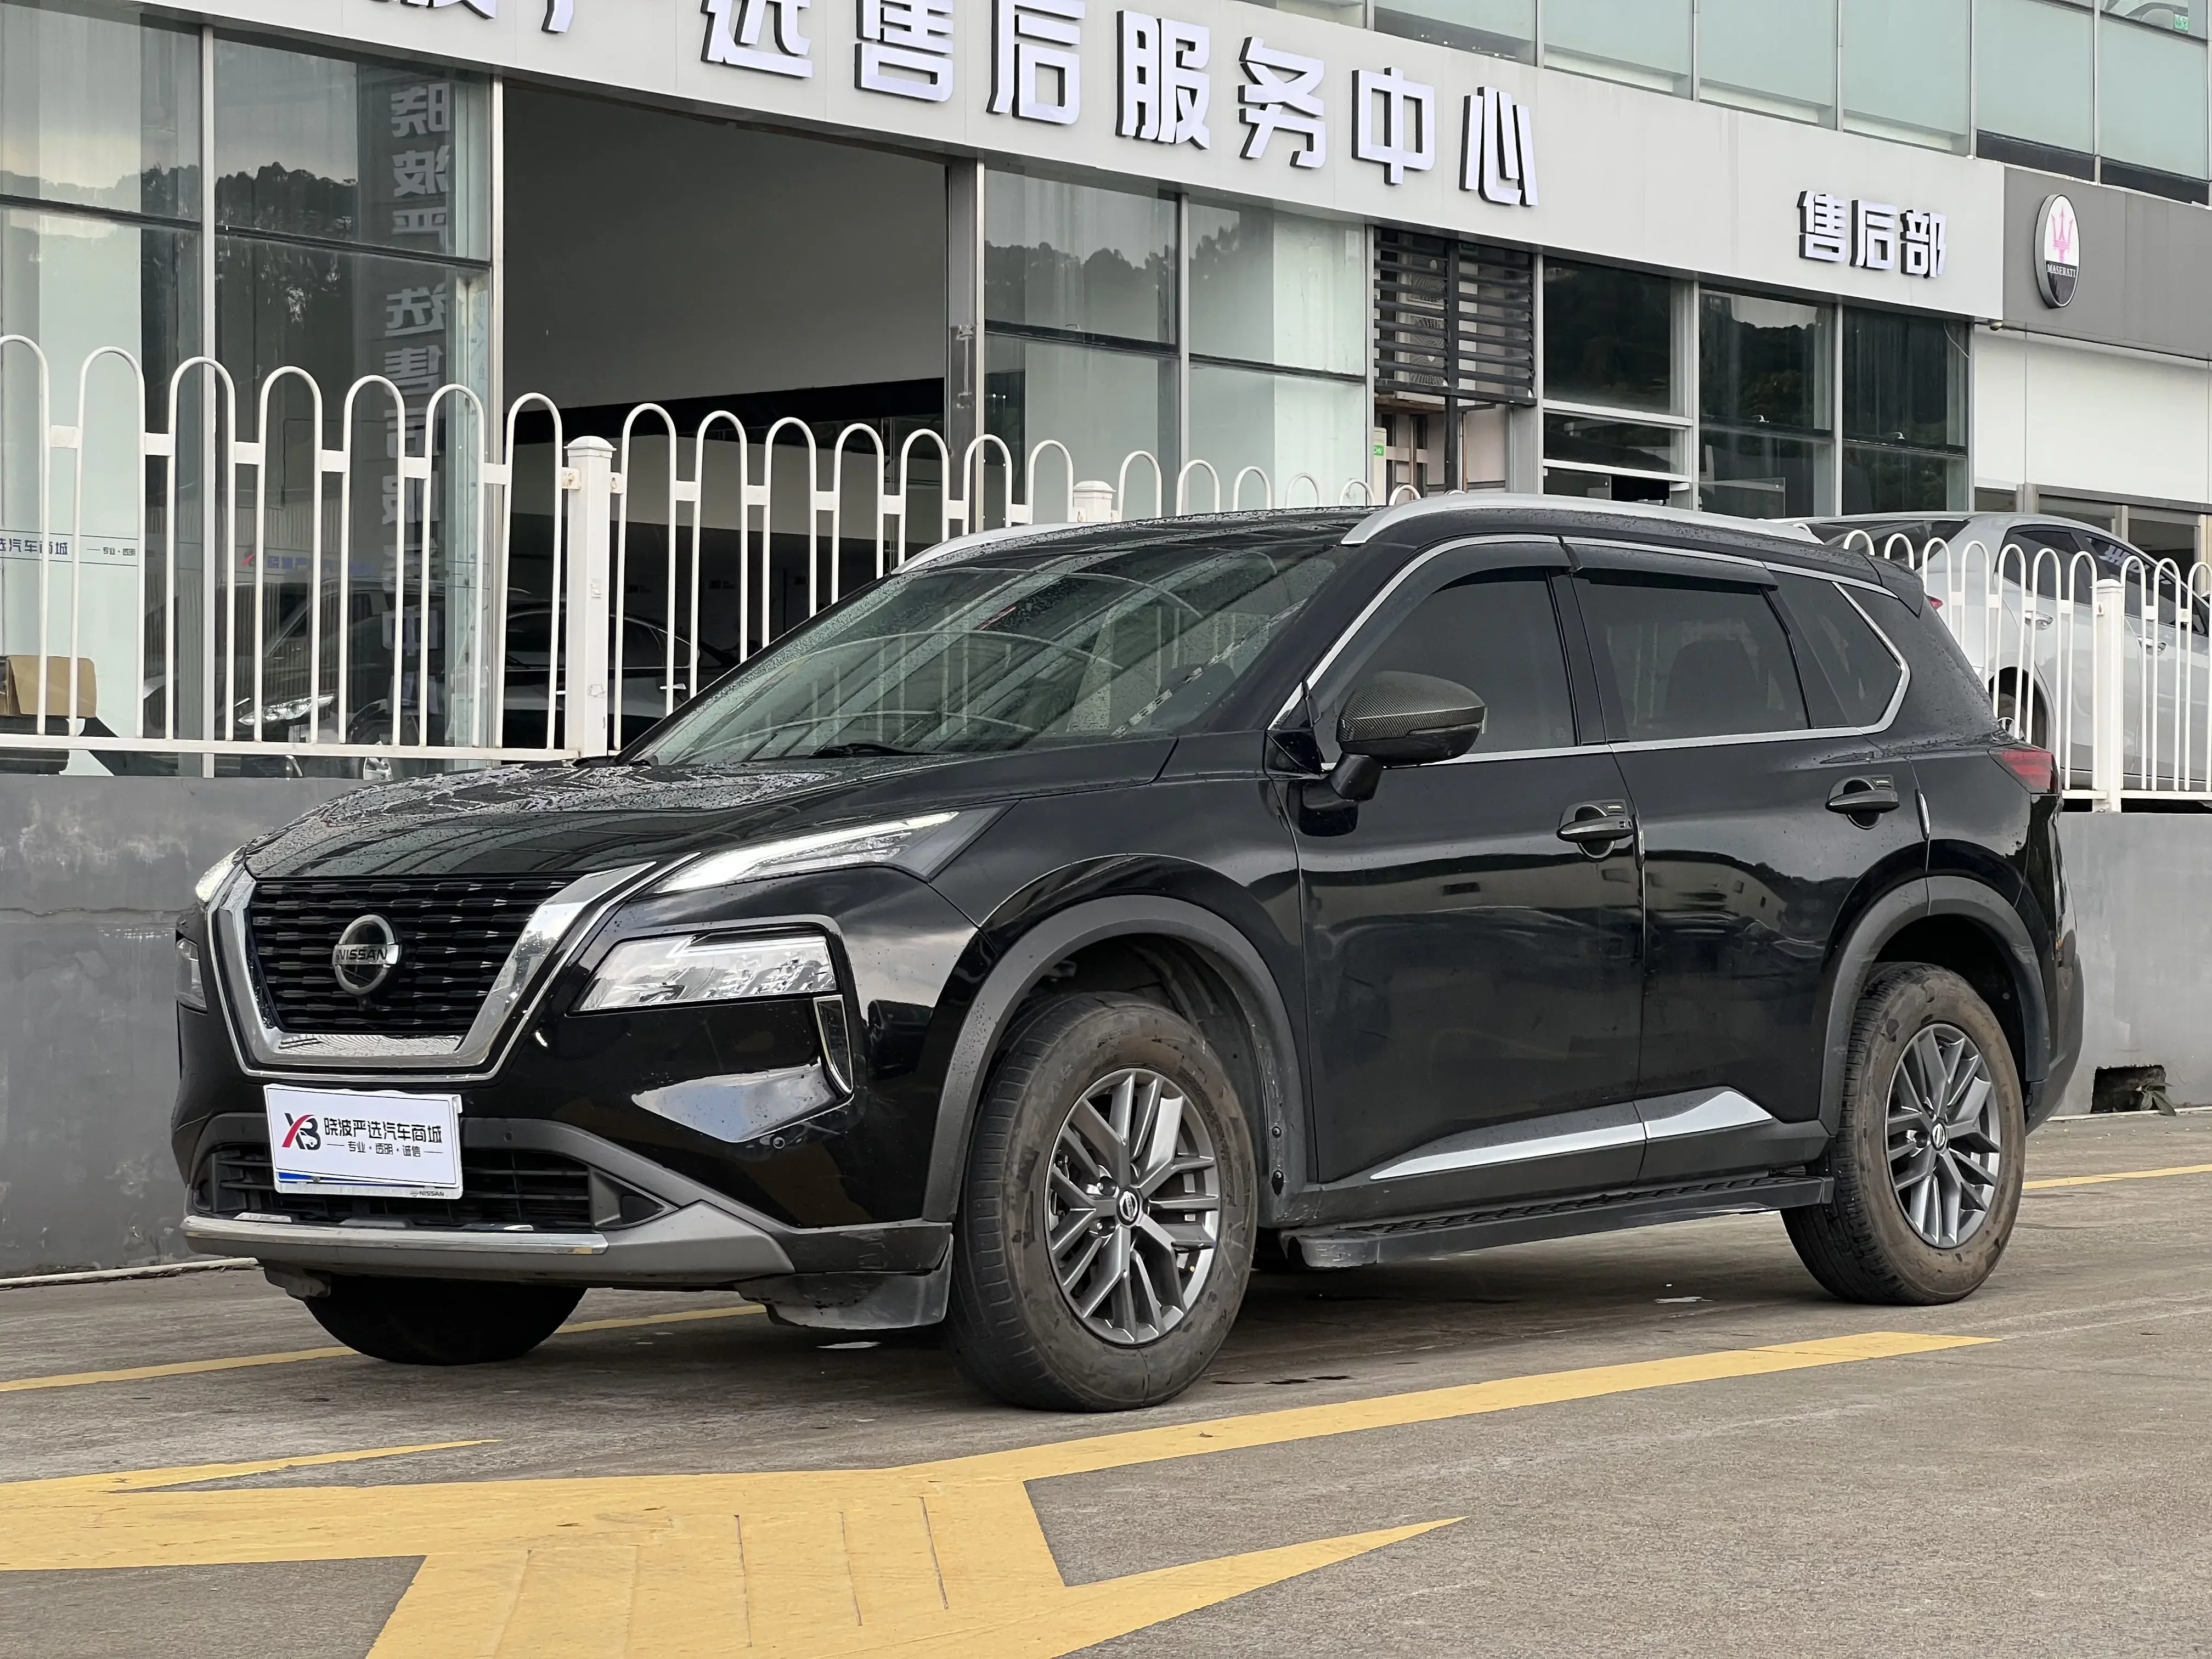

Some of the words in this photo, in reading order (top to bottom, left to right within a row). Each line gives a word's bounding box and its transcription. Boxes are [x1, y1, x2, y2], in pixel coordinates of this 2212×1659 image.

[1797, 190, 1946, 279] 售后部
[2047, 264, 2076, 278] MASERATI
[336, 949, 387, 960] NISSAN
[324, 1117, 443, 1144] 晓波严选汽车商城
